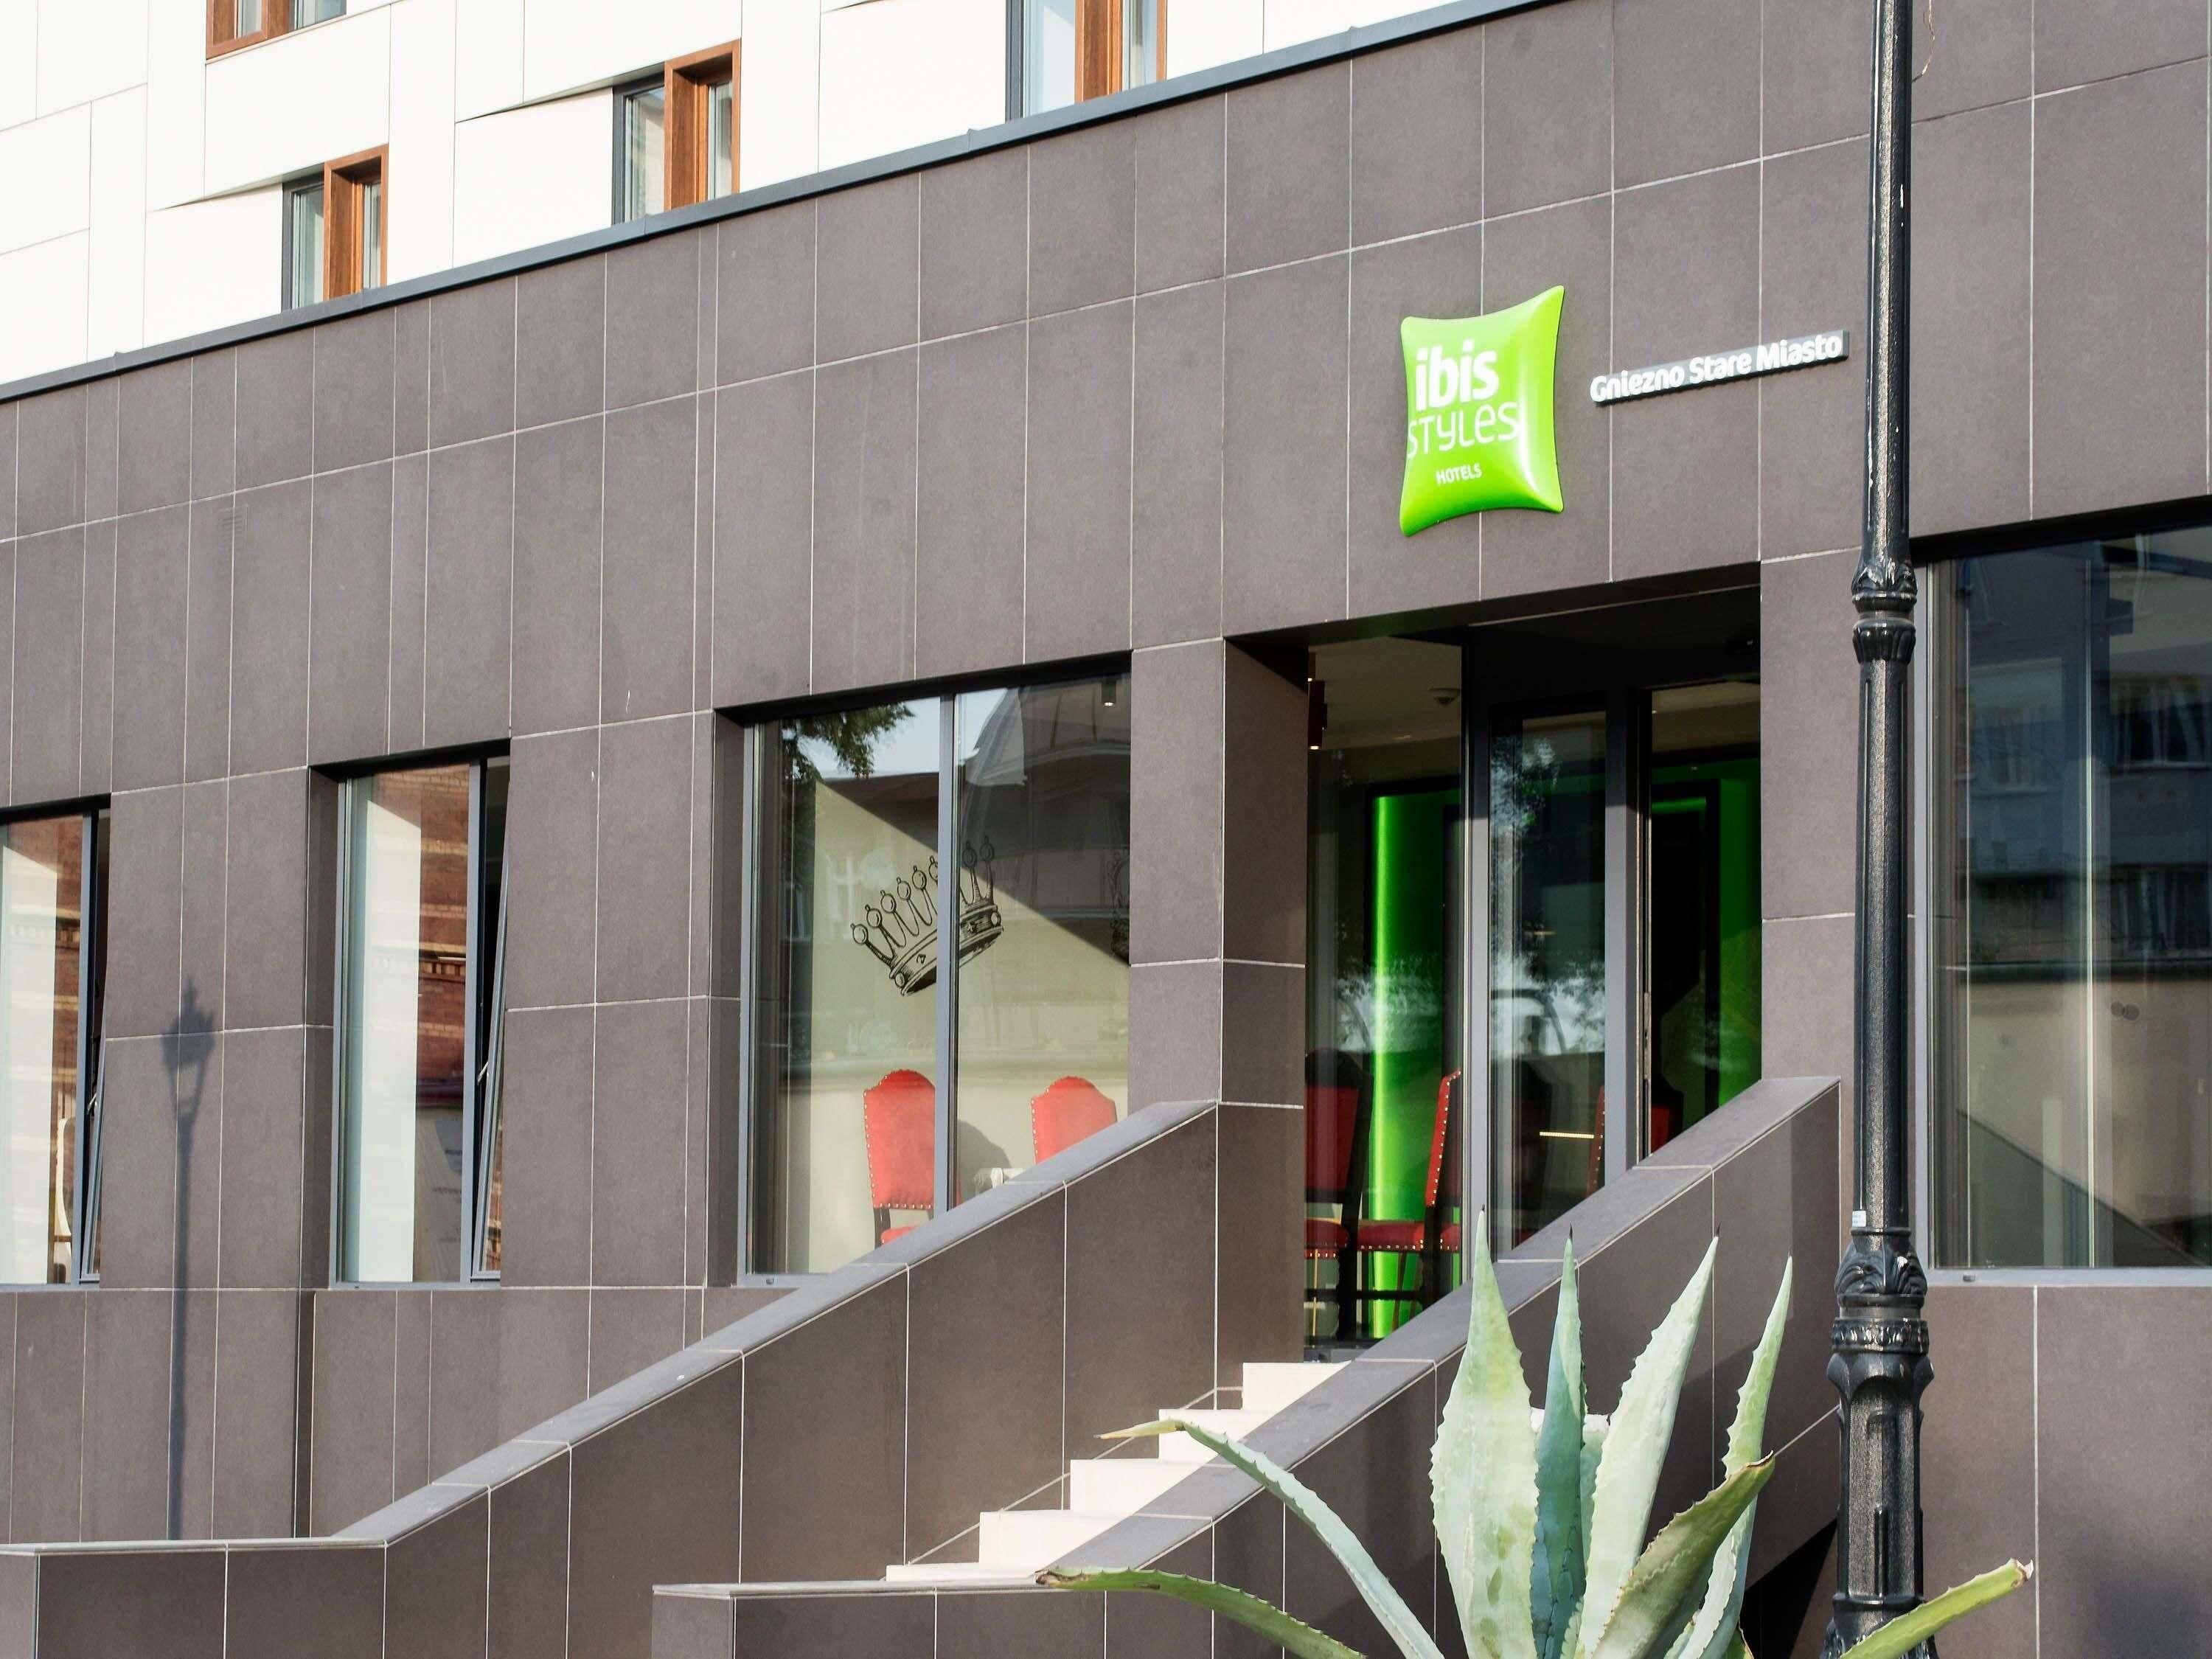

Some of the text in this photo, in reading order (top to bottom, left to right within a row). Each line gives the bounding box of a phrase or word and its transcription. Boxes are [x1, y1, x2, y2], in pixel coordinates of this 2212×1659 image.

[1415, 338, 1500, 411] ibis
[1590, 334, 1843, 403] Gniezno Stare Miasto
[1436, 463, 1483, 484] HOTELS
